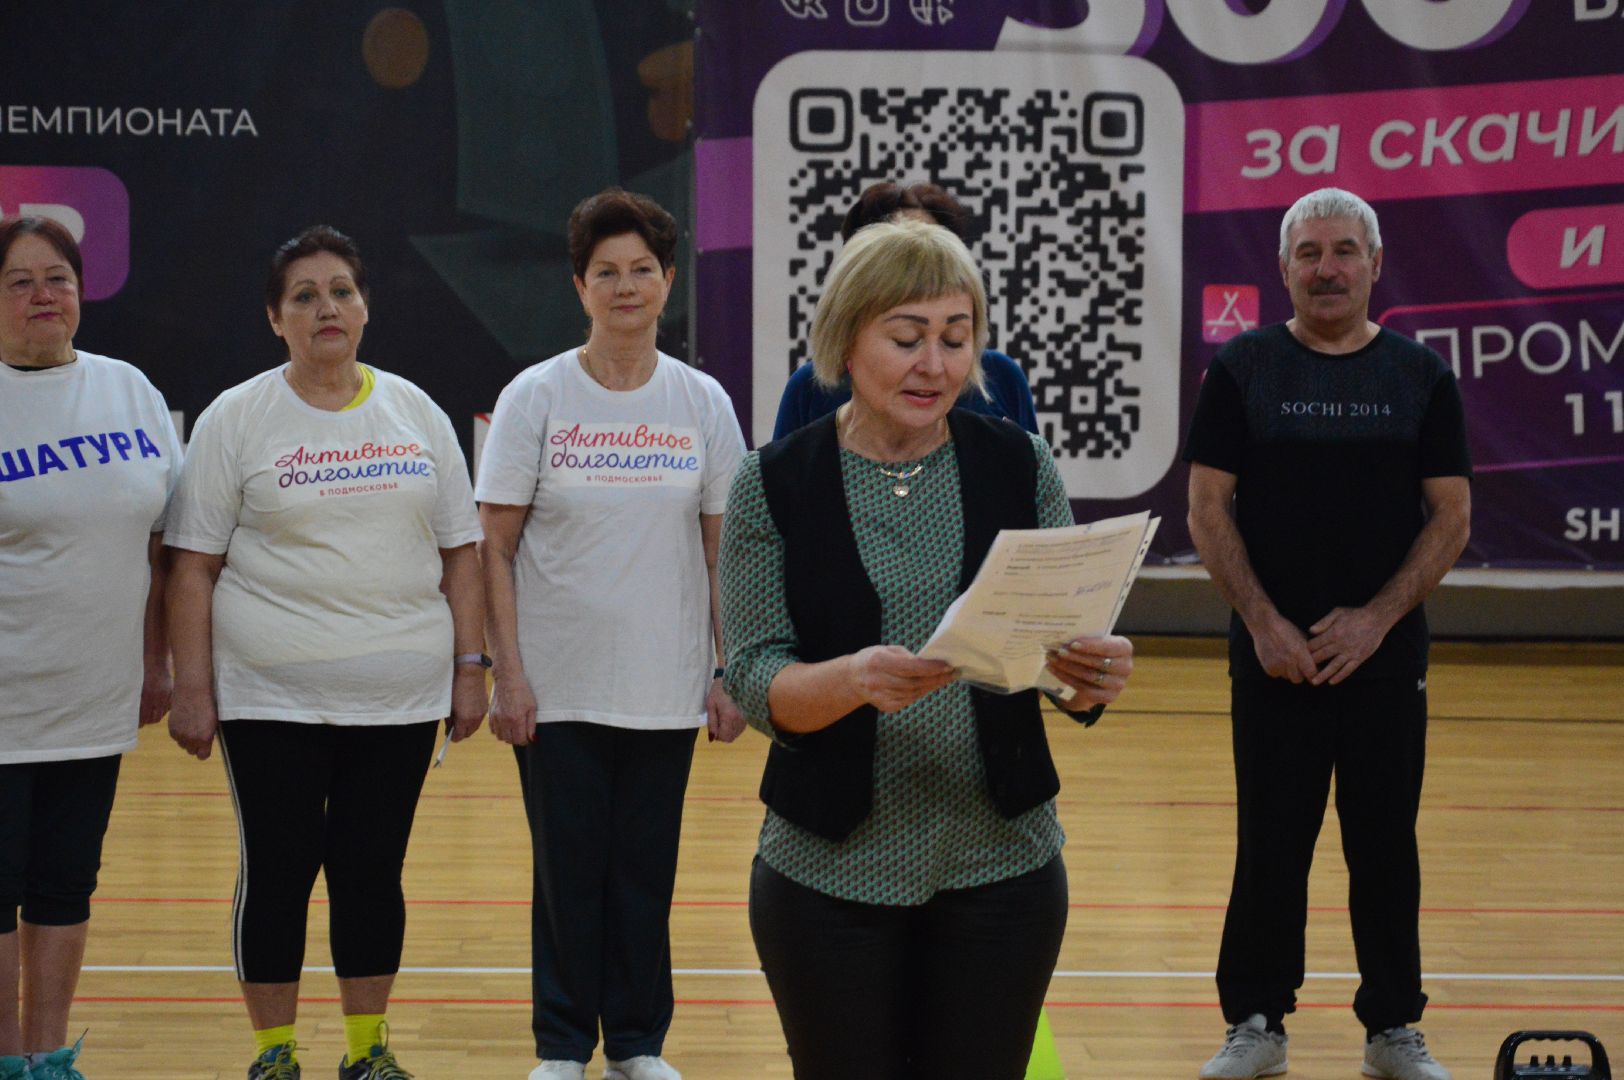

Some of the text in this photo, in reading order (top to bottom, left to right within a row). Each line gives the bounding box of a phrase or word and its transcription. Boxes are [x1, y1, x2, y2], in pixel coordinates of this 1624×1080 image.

[0, 105, 259, 137] ЕМПИОНАТА
[1240, 105, 1624, 180] за скачи
[1559, 224, 1606, 270] и
[1280, 401, 1392, 417] SOCHI 2014
[551, 423, 693, 451] Активное
[0, 428, 161, 482] ШАТУРА
[275, 442, 422, 468] Активное
[551, 443, 699, 471] долголетие
[278, 463, 431, 489] долголетие
[328, 481, 400, 496] ПОДМОСКОВЬЕ
[594, 474, 663, 483] ПОДМОСКОВЬЕ
